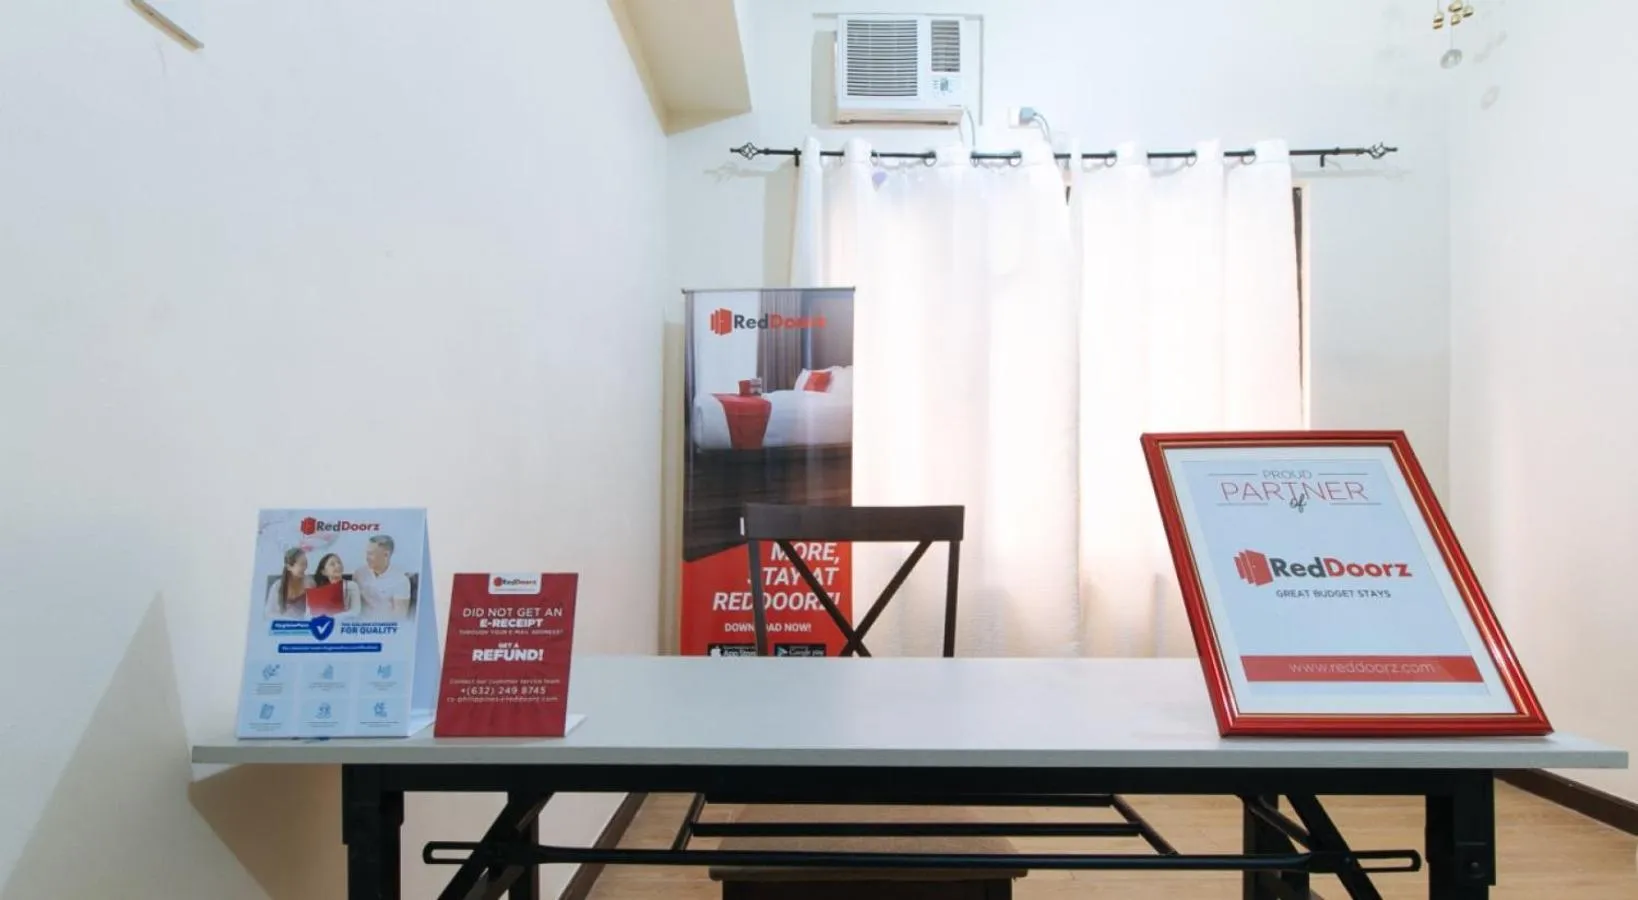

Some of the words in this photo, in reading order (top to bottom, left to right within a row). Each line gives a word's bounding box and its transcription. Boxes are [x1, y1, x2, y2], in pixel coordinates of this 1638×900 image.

[1262, 470, 1313, 480] PROUD
[1220, 482, 1369, 501] PARTNER
[316, 520, 380, 532] RedDoorz
[1269, 557, 1413, 578] RedDoorz
[748, 567, 801, 586] TAY
[1276, 589, 1310, 598] GREAT
[1314, 589, 1354, 598] BUDGET
[1358, 589, 1392, 598] STAYS
[462, 607, 484, 617] DID
[487, 607, 513, 617] NOT
[516, 607, 540, 617] GET
[544, 607, 563, 617] AN
[479, 618, 544, 628] E-RECEIPT
[724, 622, 782, 632] DOWNAD
[340, 627, 358, 635] FOR
[360, 626, 397, 635] QUALITY
[472, 649, 544, 661] REFUND!
[1289, 662, 1436, 674] www.reddoorz.com
[461, 686, 495, 696] +(632)
